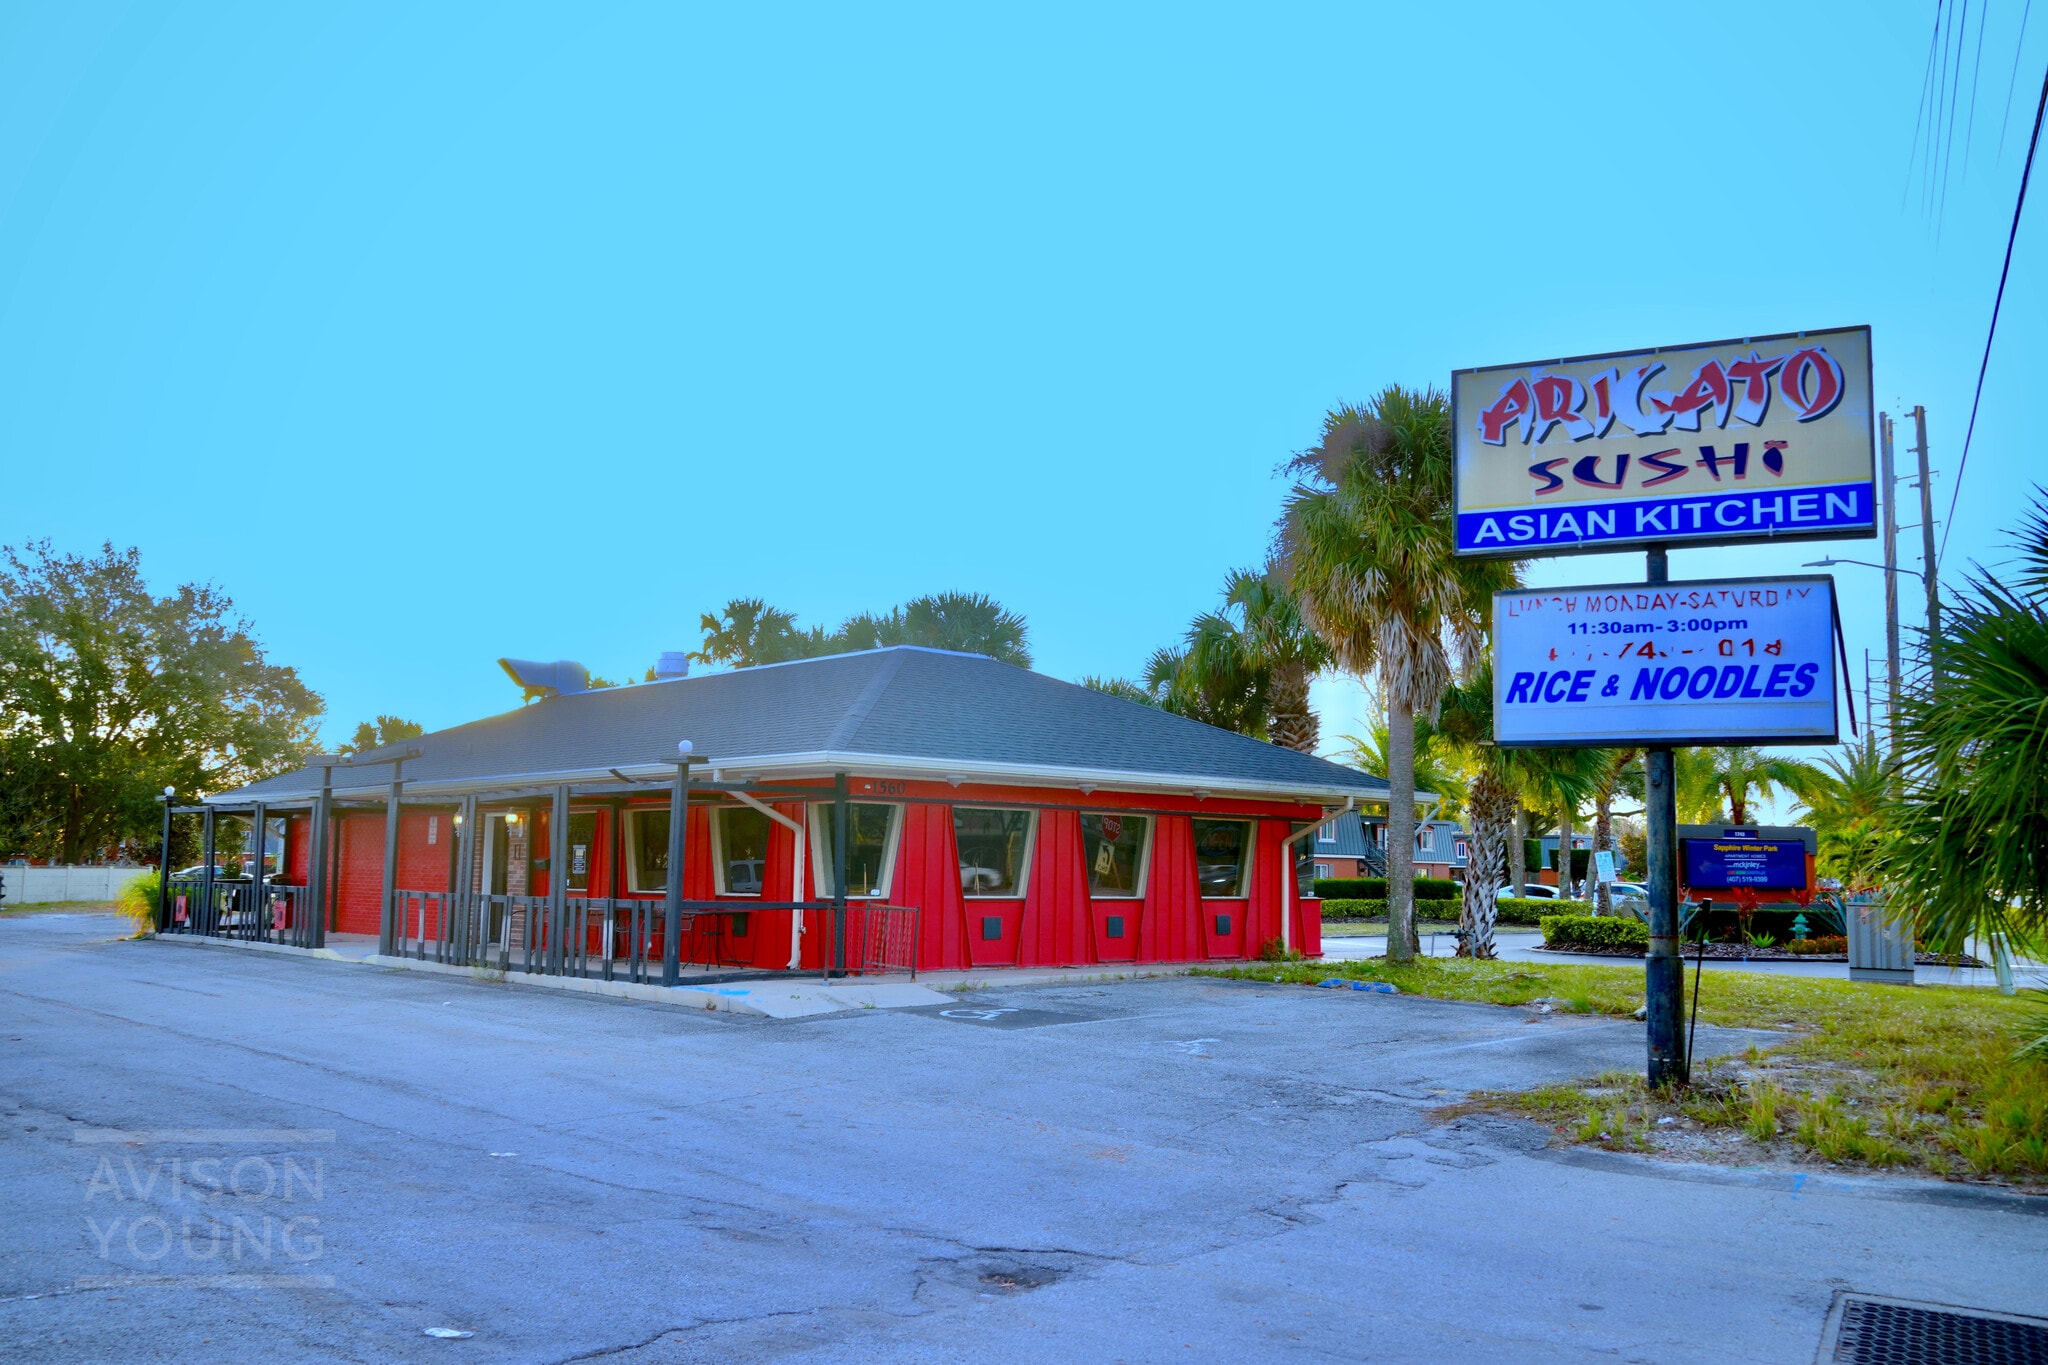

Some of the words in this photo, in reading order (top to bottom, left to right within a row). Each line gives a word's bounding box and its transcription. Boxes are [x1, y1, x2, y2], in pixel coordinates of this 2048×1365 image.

[1476, 345, 1844, 446] ARIGATO
[1473, 509, 1615, 544] ASIAN
[1636, 490, 1858, 533] KITCHEN
[1505, 670, 1597, 704] RICE
[1601, 674, 1620, 697] &
[1630, 662, 1819, 701] NOODLES
[872, 780, 906, 795] 1560
[1713, 844, 1741, 852] Sapphire
